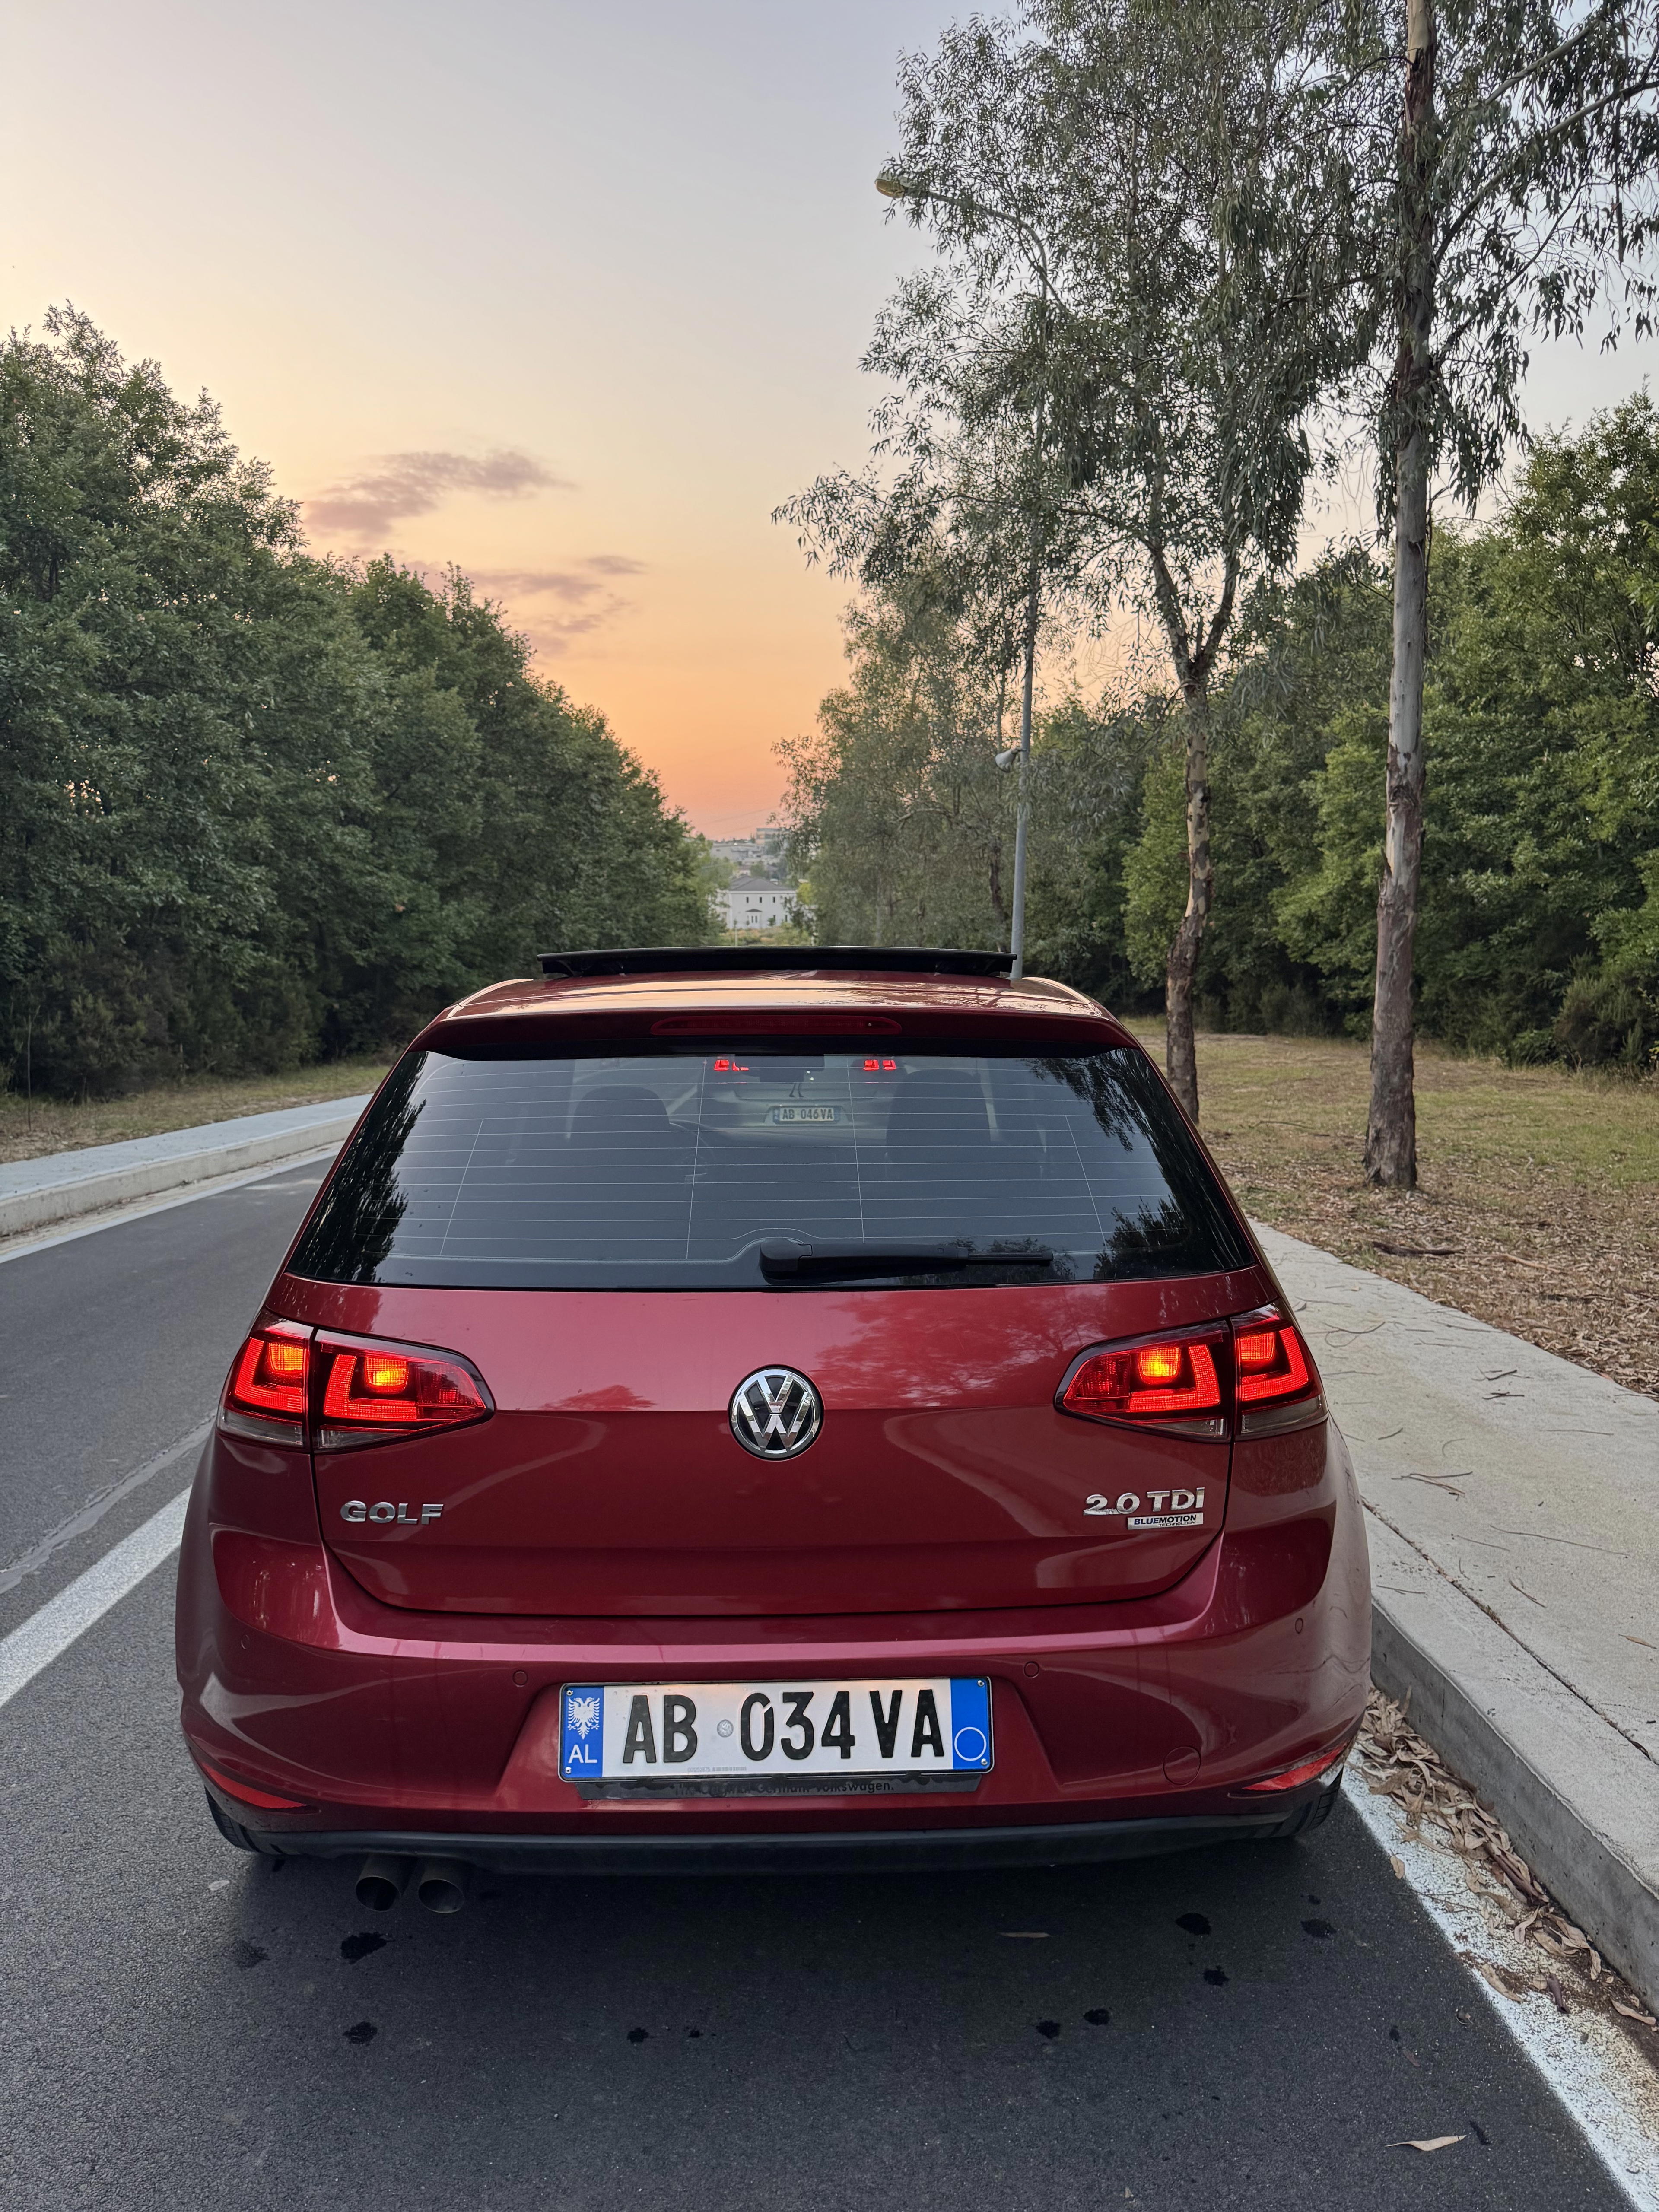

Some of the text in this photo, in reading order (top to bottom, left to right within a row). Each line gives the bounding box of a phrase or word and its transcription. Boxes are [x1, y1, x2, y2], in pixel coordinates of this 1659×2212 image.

[782, 1108, 833, 1120] AB 046 VA
[731, 1368, 820, 1459] VW
[340, 1500, 444, 1525] GOLF
[1083, 1487, 1205, 1515] 2.0 TDI
[1134, 1514, 1196, 1525] BLUEMOTION
[623, 1689, 945, 1764] AB 034 VA
[568, 1744, 598, 1764] AL
